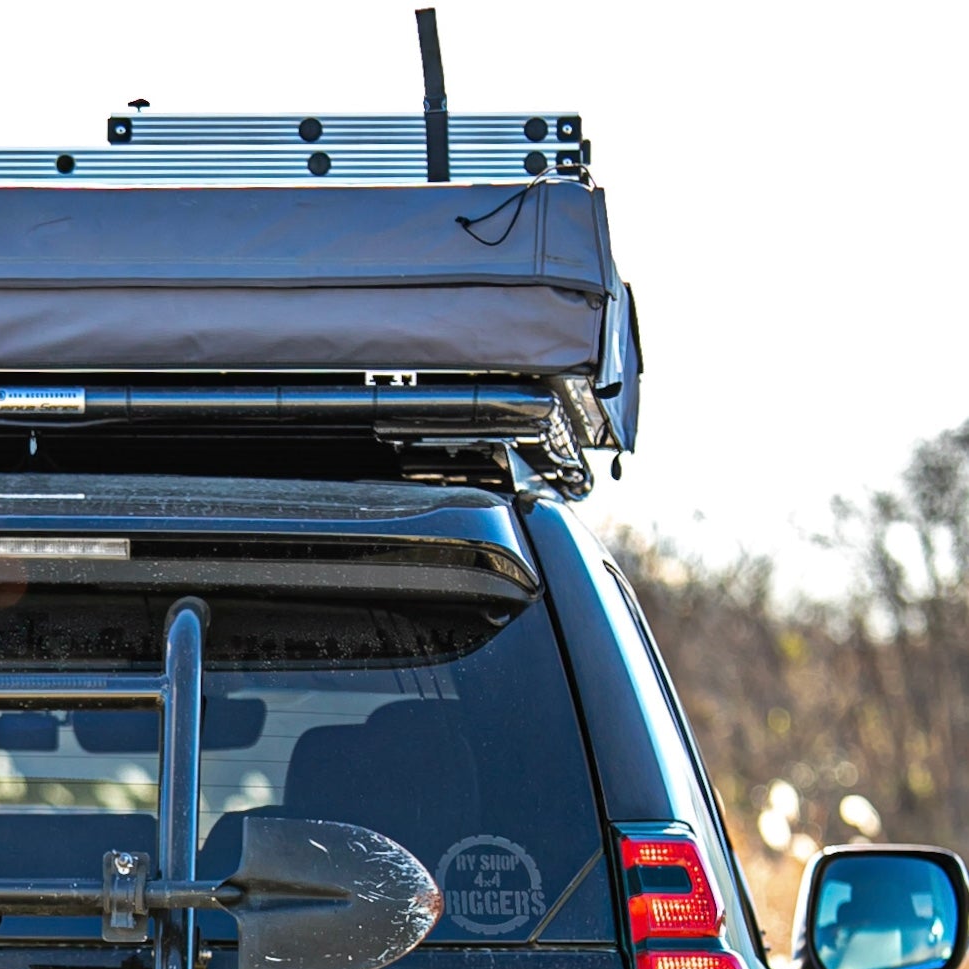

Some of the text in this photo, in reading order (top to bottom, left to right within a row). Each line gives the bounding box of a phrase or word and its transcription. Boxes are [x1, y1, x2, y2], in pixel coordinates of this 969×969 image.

[455, 854, 520, 871] RV SHOP
[473, 871, 501, 888] 4x4
